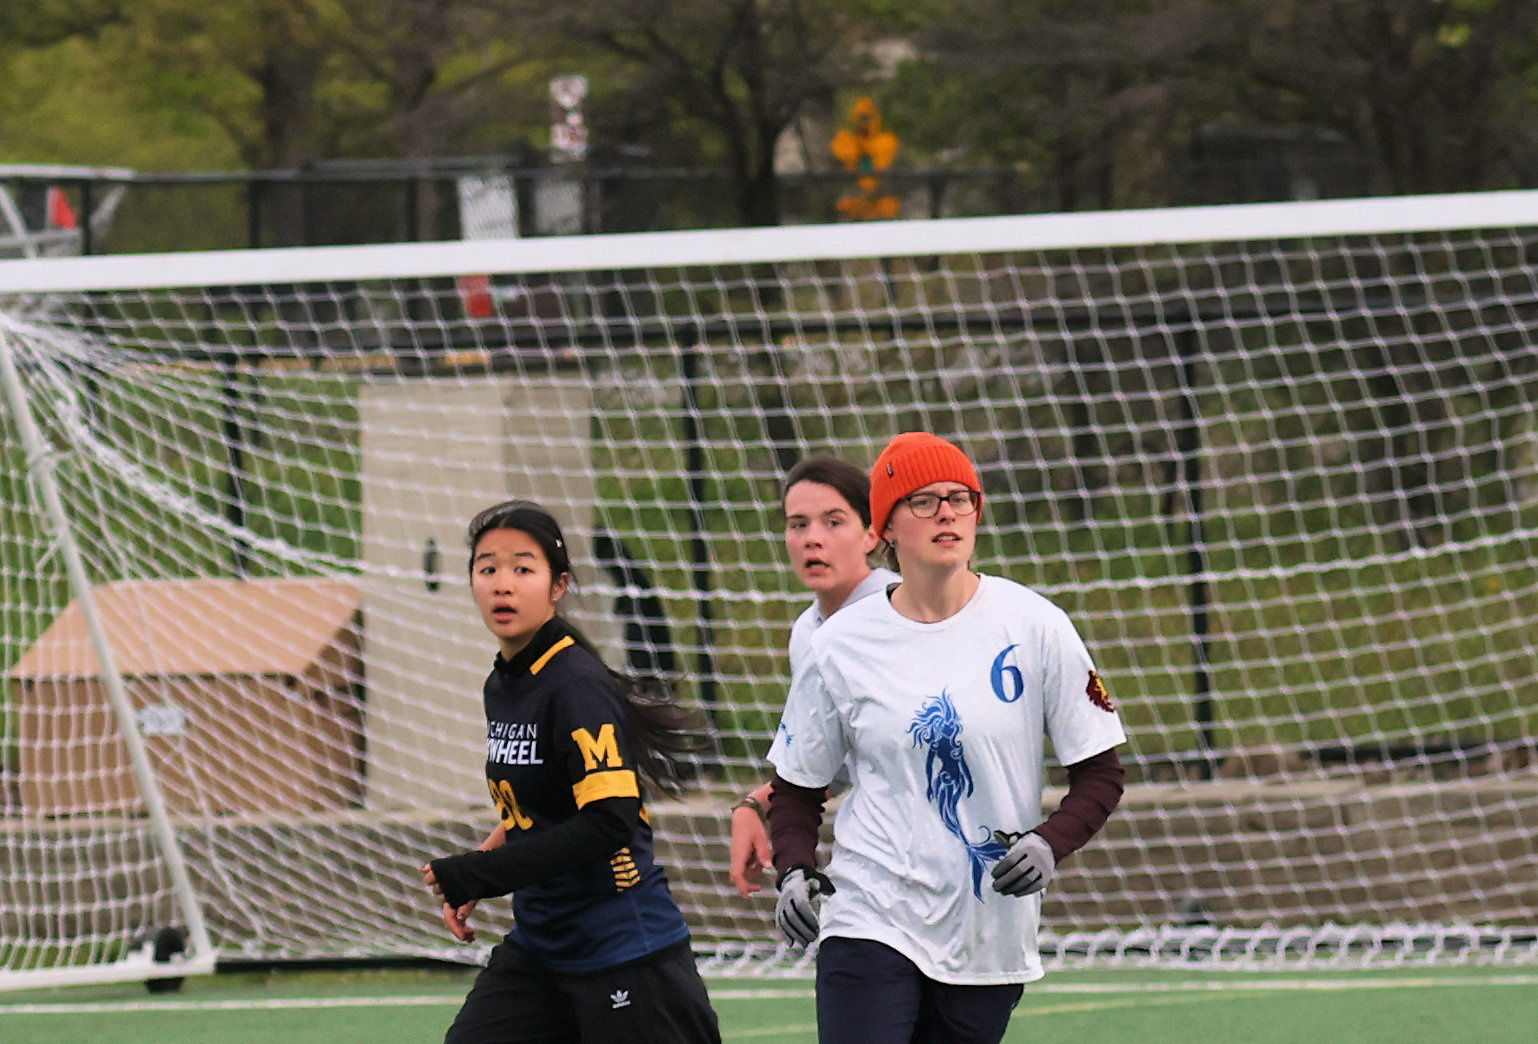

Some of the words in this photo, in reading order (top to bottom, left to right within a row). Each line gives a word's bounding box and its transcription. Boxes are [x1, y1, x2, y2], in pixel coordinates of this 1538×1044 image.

[989, 643, 1024, 703] 6
[488, 720, 537, 739] CHIGAN
[571, 723, 623, 772] M
